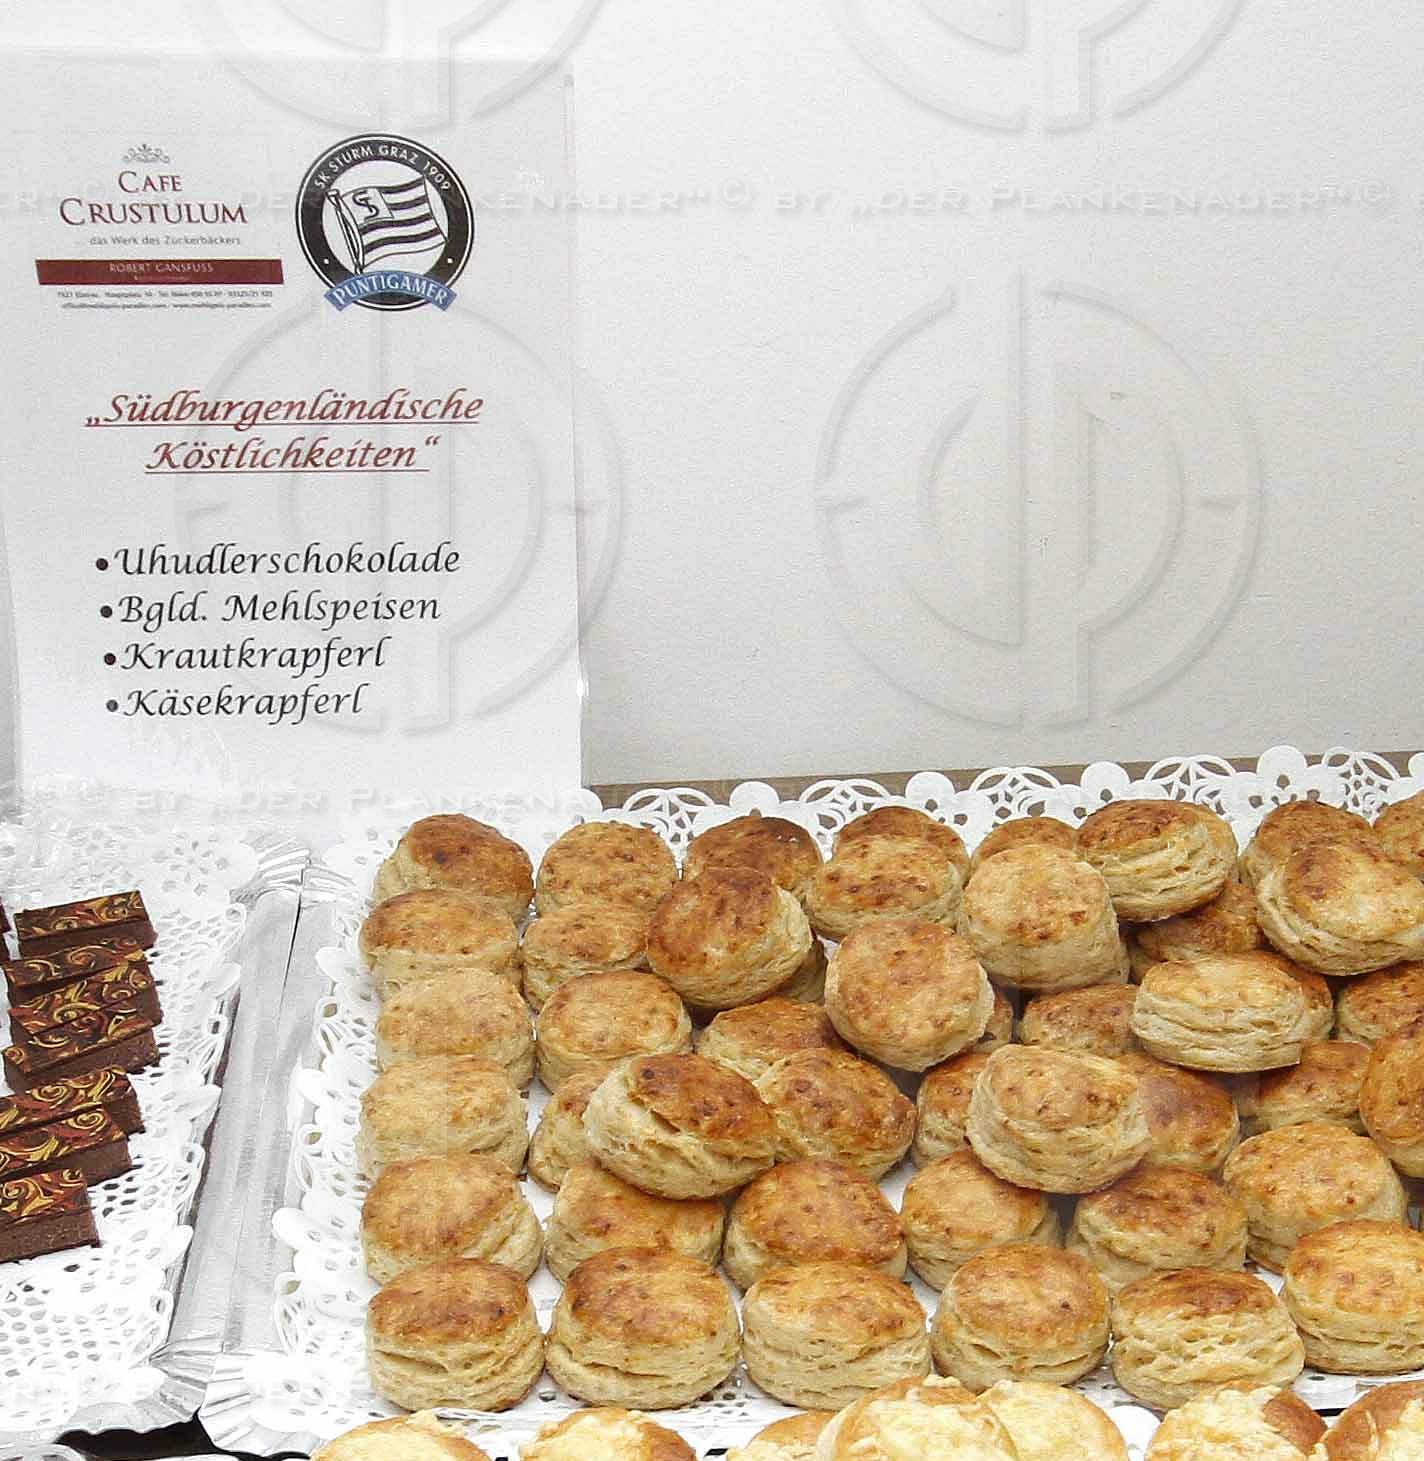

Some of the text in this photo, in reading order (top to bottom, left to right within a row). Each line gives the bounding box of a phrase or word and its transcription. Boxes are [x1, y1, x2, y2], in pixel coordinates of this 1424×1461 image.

[314, 144, 452, 190] SK STURM GRAZ 1909
[109, 263, 151, 273] ROBERT
[333, 274, 448, 305] PUNTIGAMER
[85, 387, 484, 432] „Südburgenländische
[114, 541, 461, 576] Uhudlerschokolade
[118, 590, 442, 633] Bgld. Mehlspeisen
[120, 636, 393, 678] Krautkrapferl
[123, 683, 370, 725] Käsekrapferl
